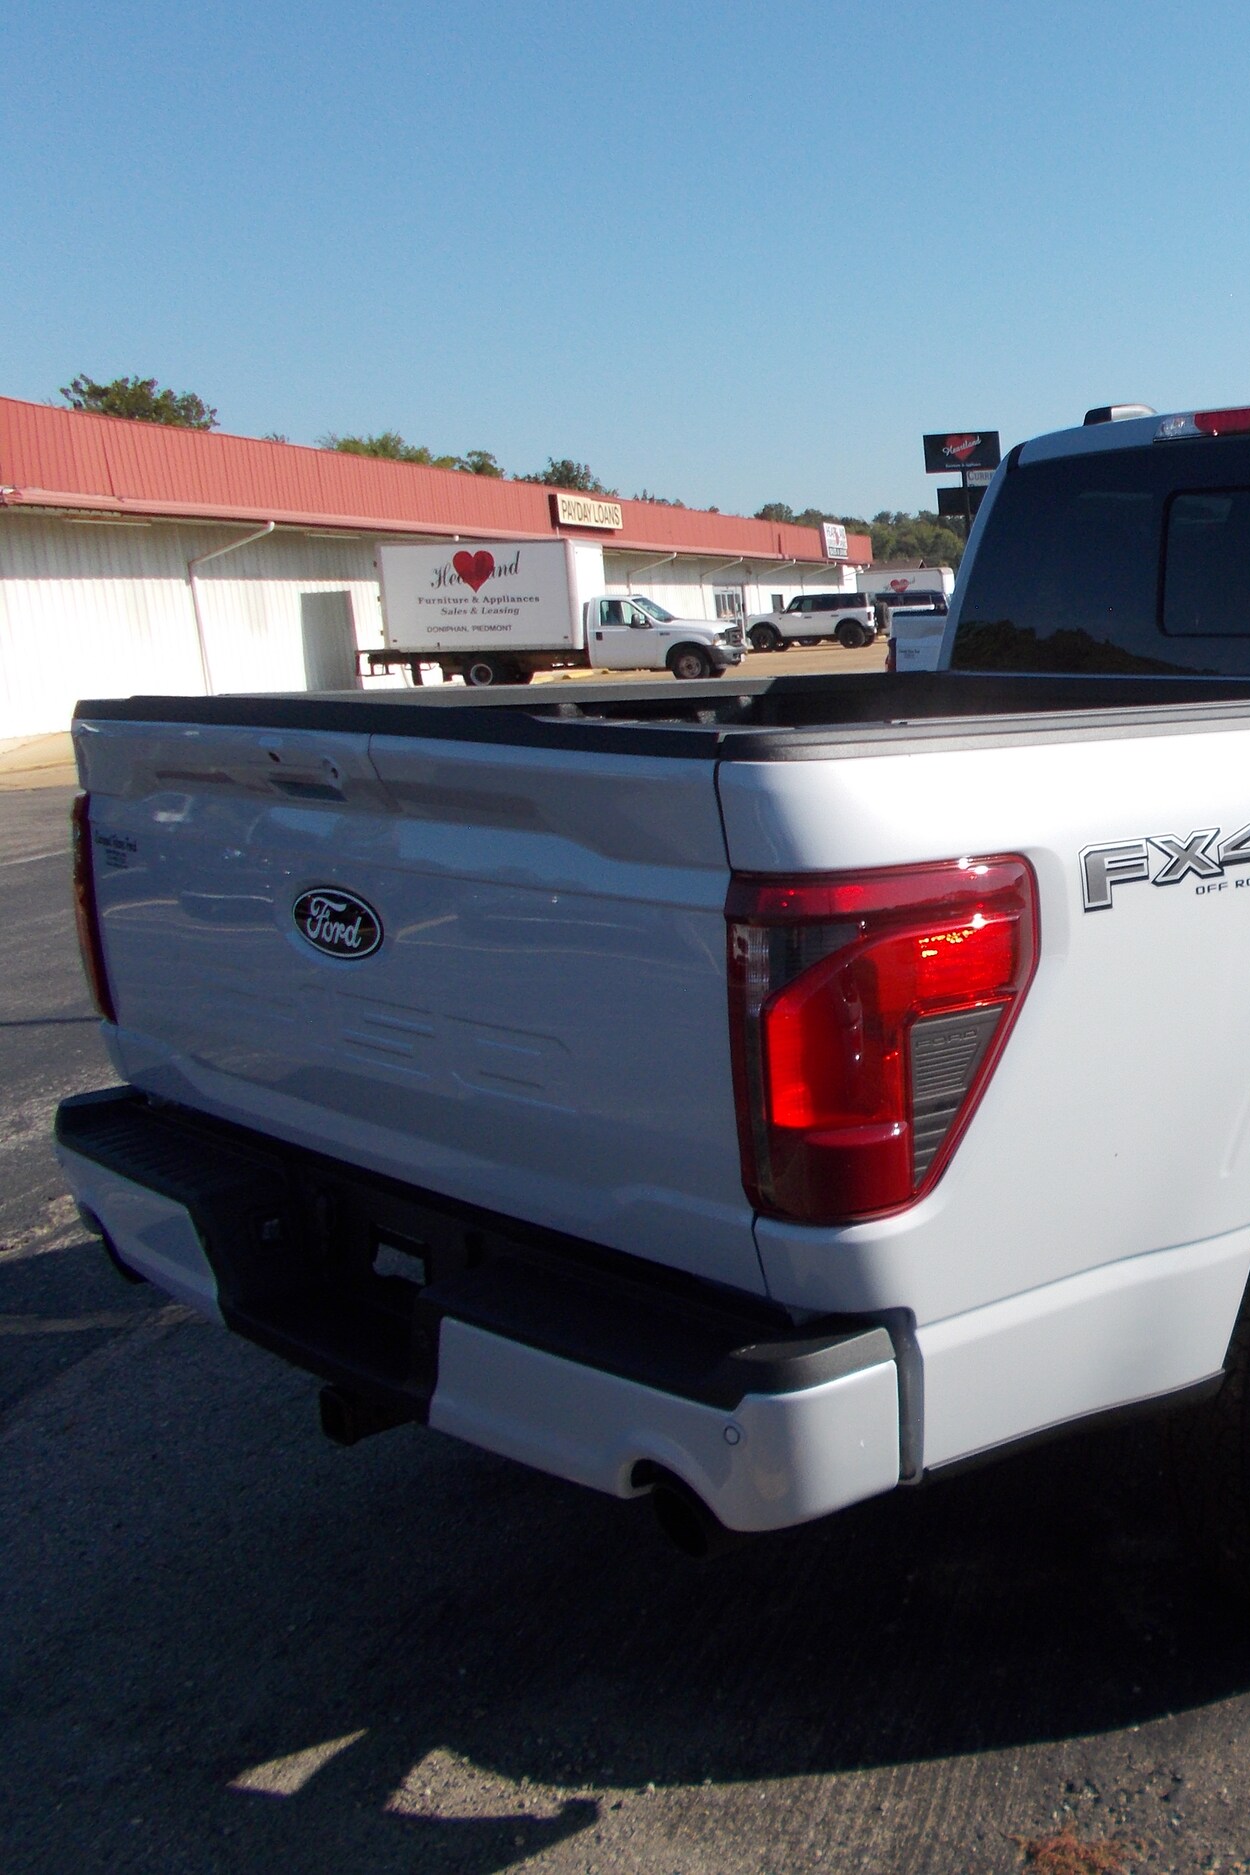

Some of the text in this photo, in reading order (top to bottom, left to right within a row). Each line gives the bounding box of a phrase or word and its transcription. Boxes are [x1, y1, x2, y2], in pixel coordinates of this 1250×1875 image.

[942, 435, 982, 456] Heartland
[561, 499, 620, 526] PAYDAY LOANS
[418, 594, 541, 605] Furniture & Appliances
[441, 606, 520, 616] Sales & Leasing
[472, 624, 513, 633] PIEDMONT
[1195, 881, 1228, 895] OFF
[306, 896, 363, 949] Ford
[915, 1028, 977, 1050] FORD
